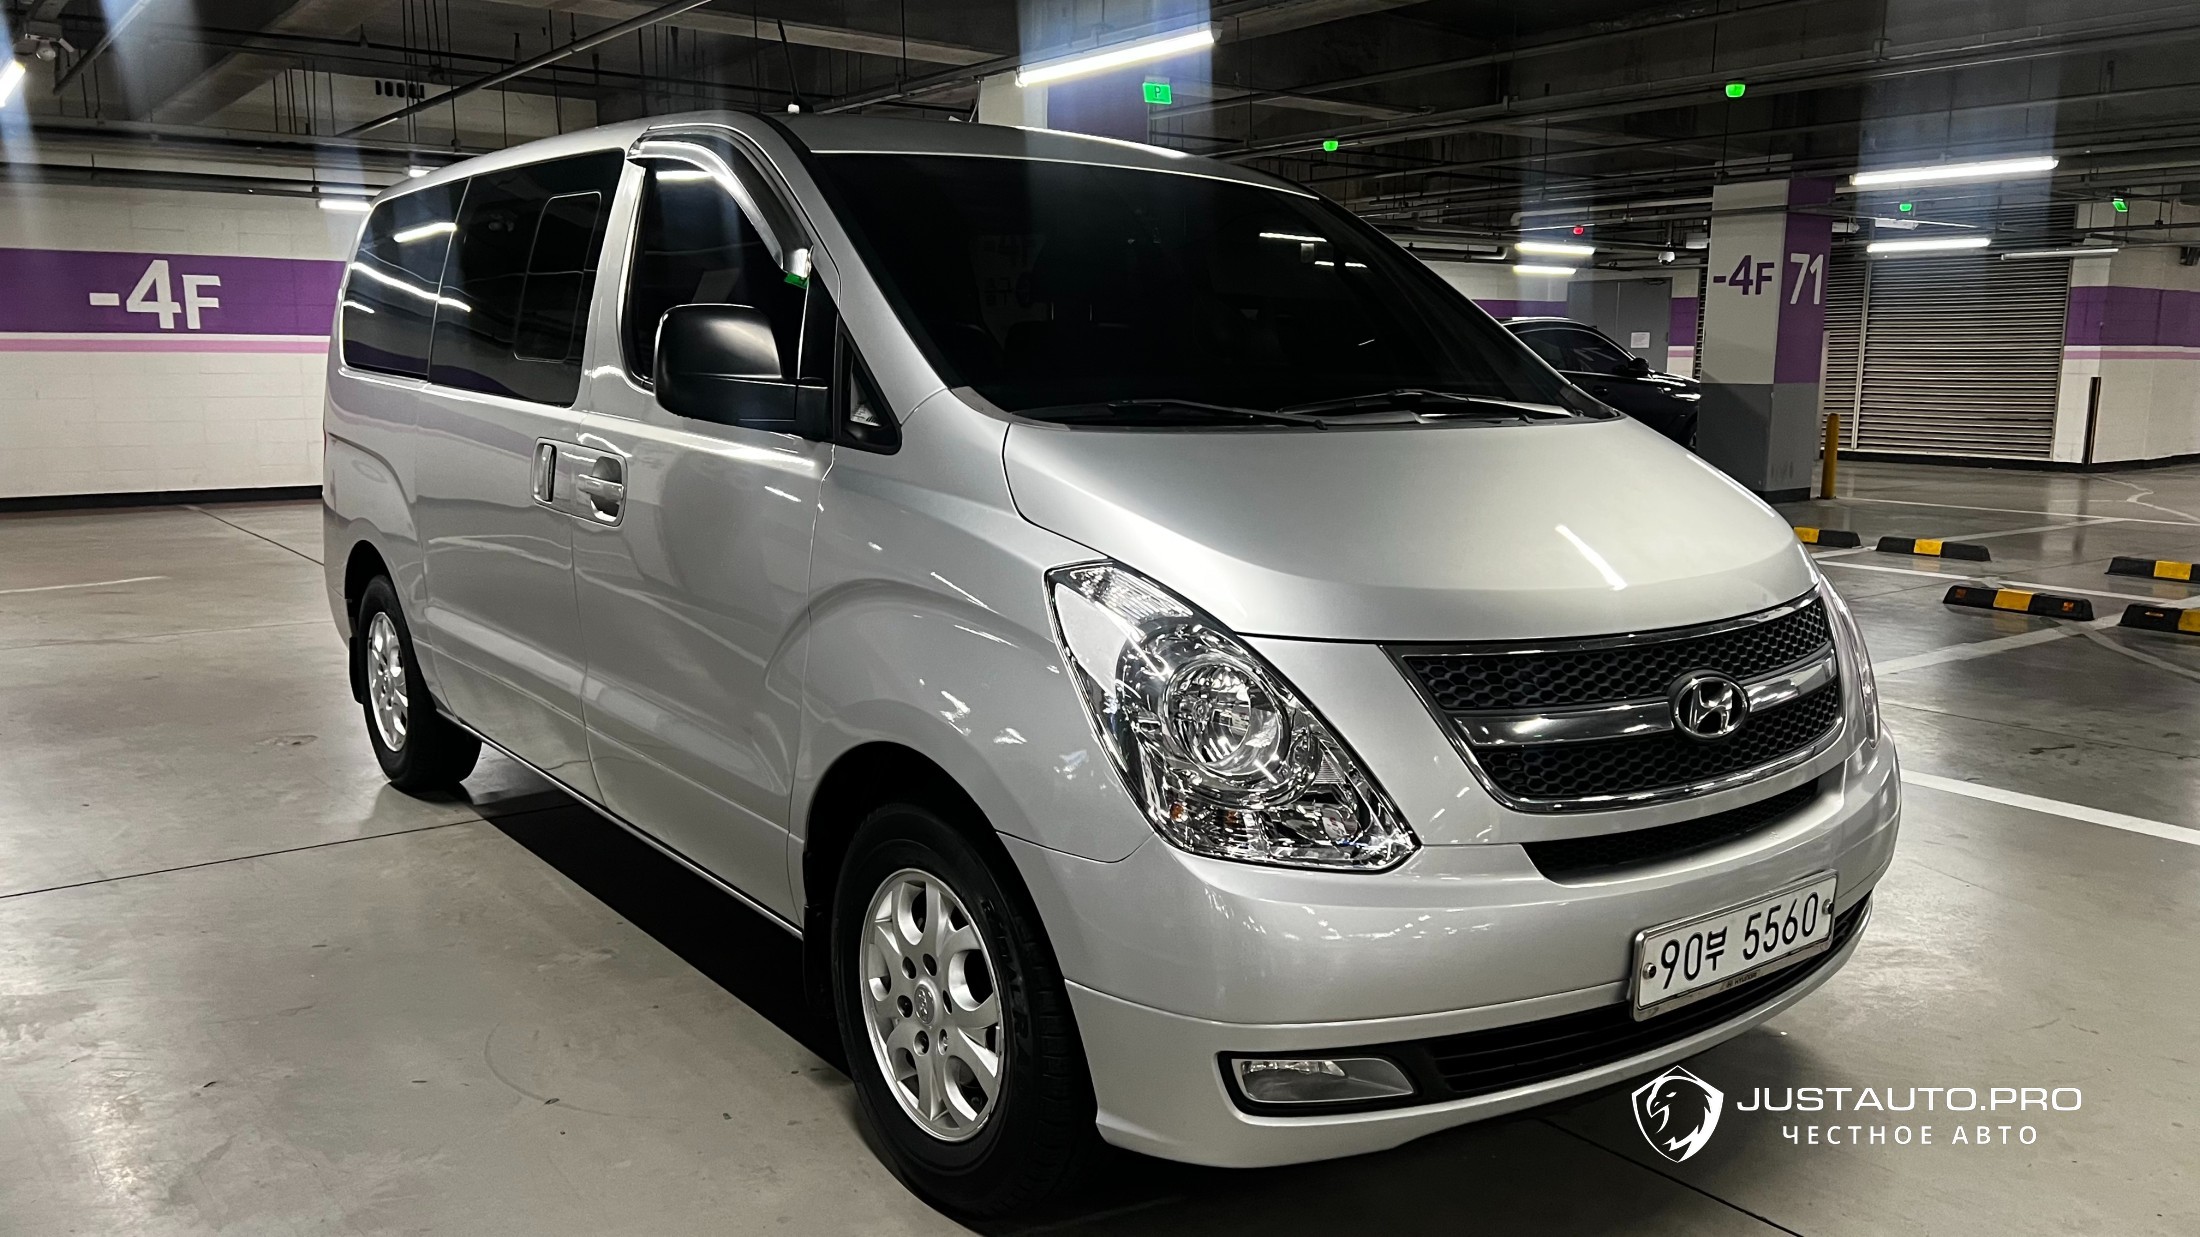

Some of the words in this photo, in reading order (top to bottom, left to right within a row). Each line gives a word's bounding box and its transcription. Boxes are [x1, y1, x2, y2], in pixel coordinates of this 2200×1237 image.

[89, 259, 222, 330] -4F
[1712, 255, 1775, 295] -4F
[1789, 252, 1824, 305] 71
[1660, 925, 1728, 990] 90부
[1742, 891, 1819, 961] 5560
